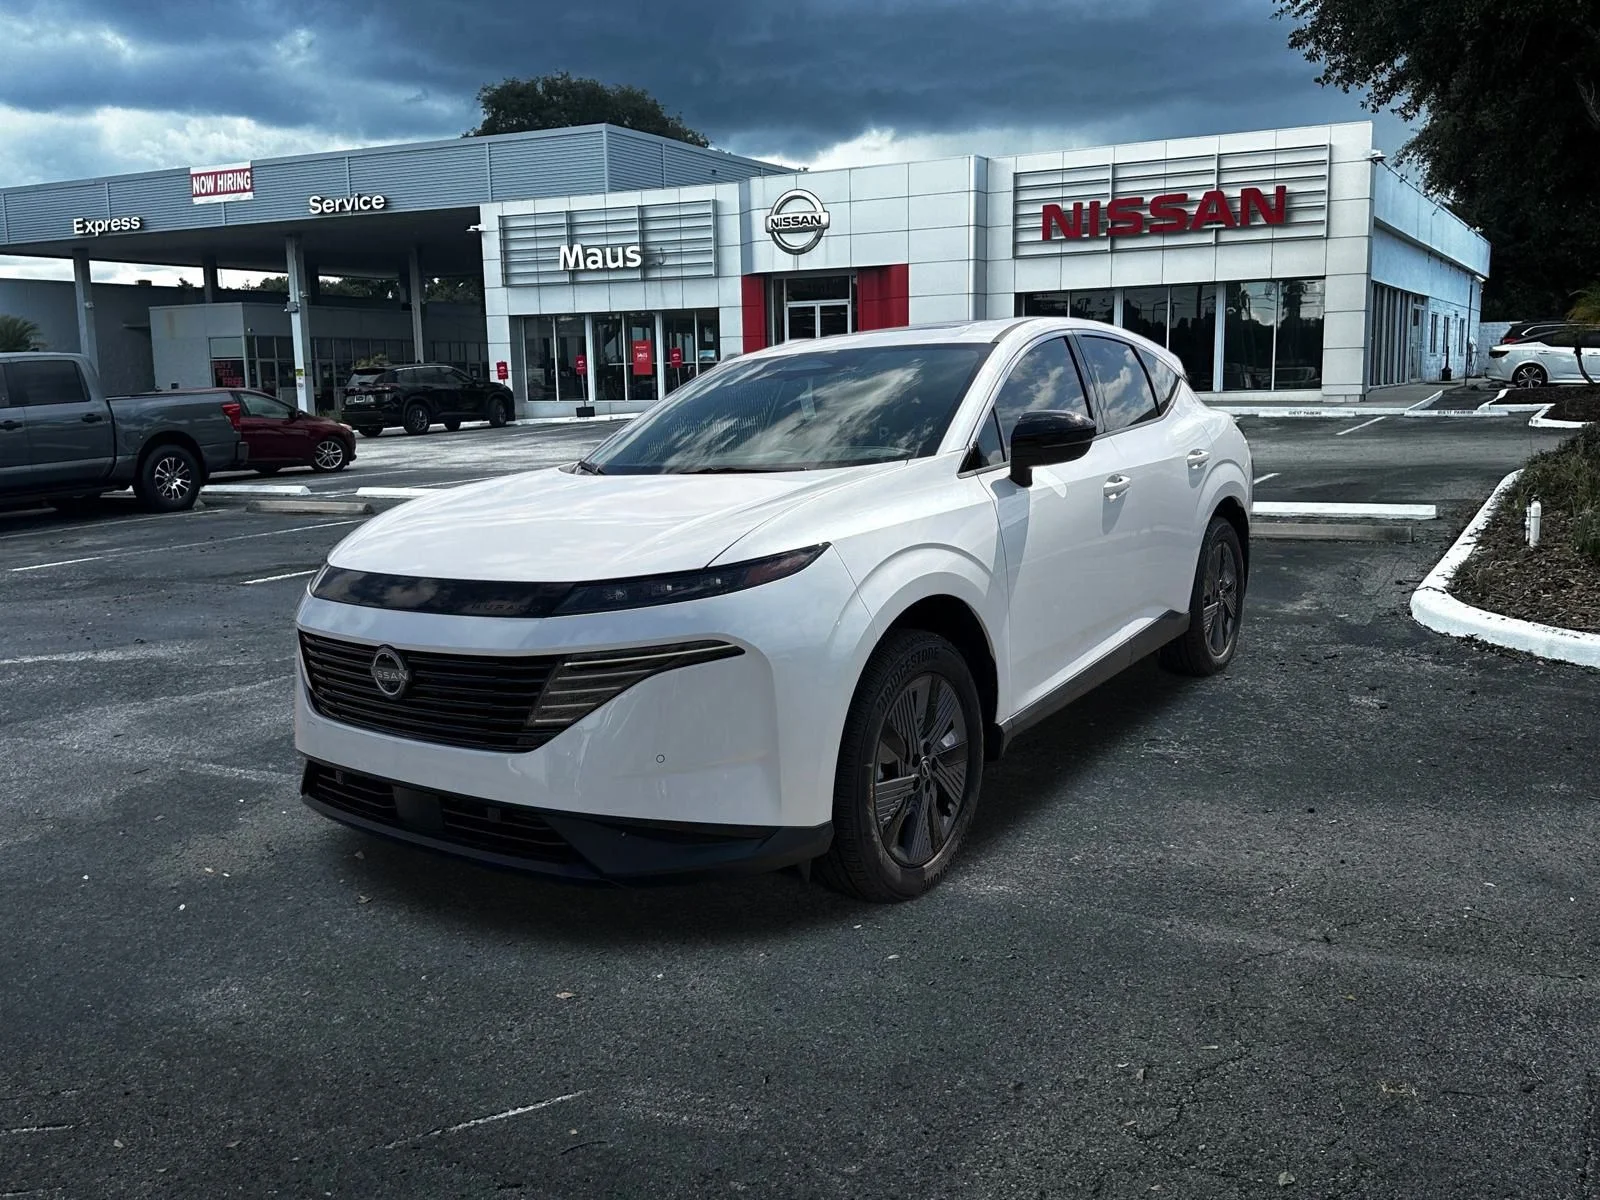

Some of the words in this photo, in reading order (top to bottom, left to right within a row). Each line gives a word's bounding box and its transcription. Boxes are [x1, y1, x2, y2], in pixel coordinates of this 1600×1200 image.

[193, 174, 215, 195] NOW
[217, 170, 251, 193] HIRING
[309, 193, 385, 215] Service
[1041, 185, 1287, 241] NISSAN
[73, 215, 141, 236] Express
[770, 215, 822, 228] NISSAN
[559, 243, 642, 271] Maus
